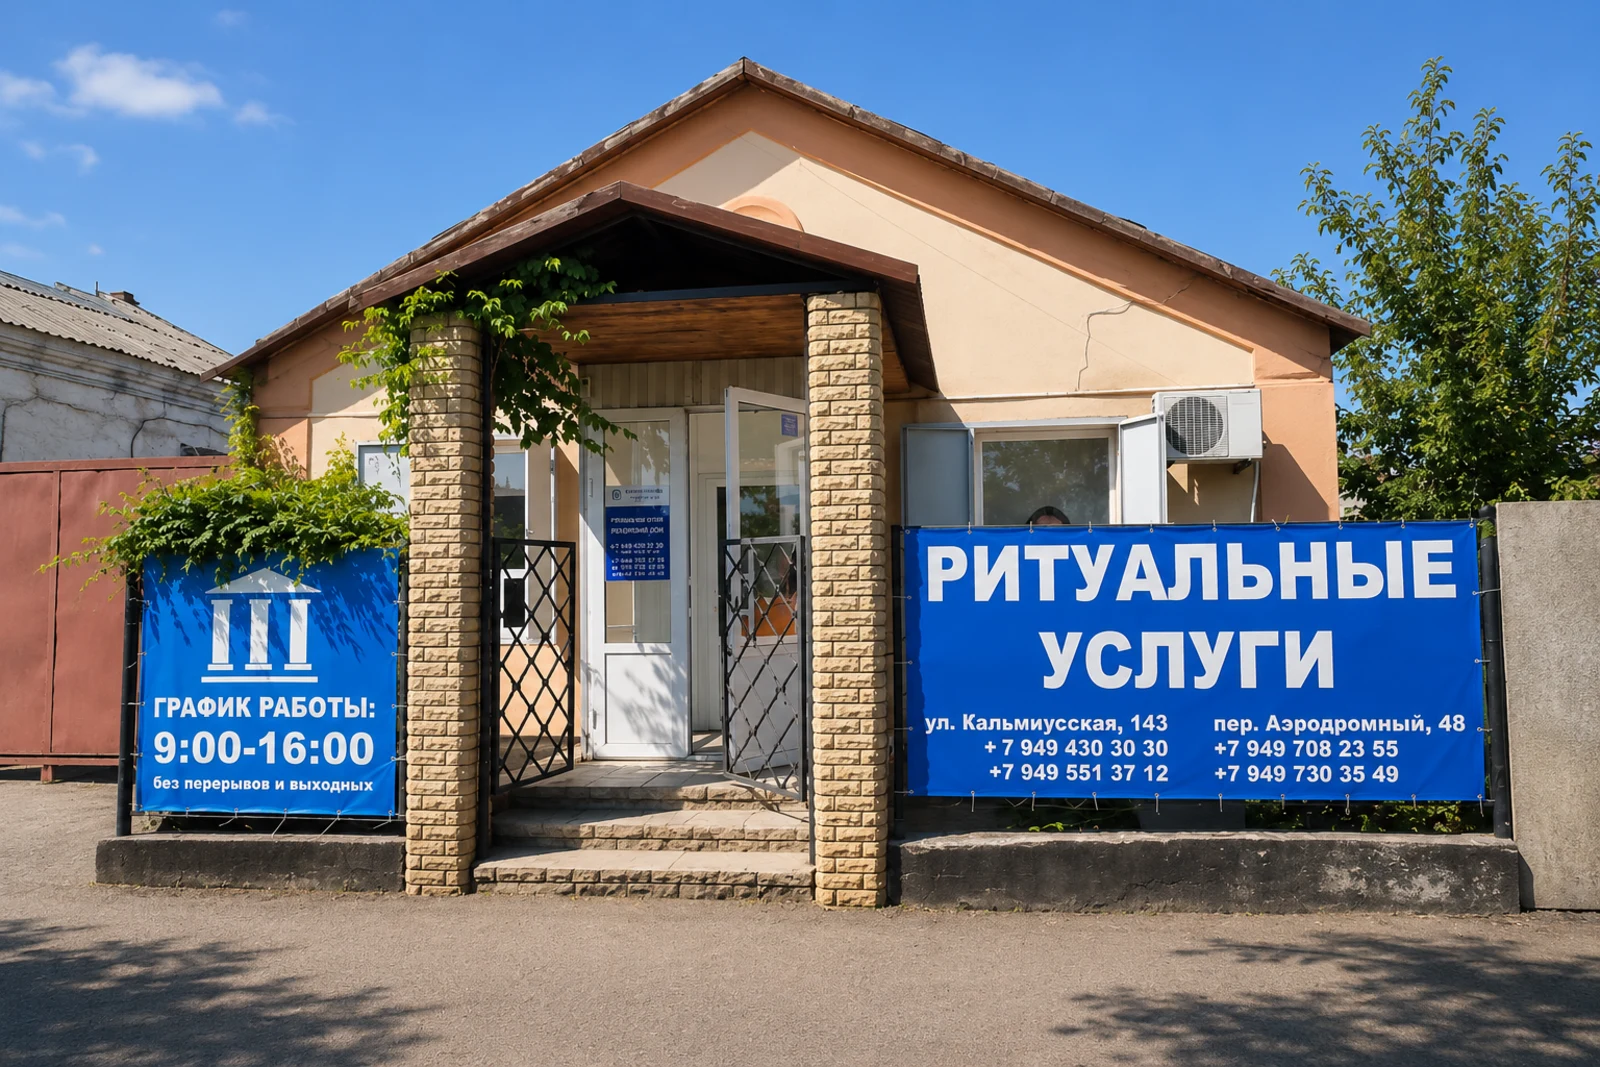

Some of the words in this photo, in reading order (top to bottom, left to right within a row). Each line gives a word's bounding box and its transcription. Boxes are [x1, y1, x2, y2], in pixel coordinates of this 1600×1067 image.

[927, 539, 1457, 602] РИТУАЛЬНЫЕ
[1038, 630, 1334, 690] УСЛУГИ
[154, 696, 252, 718] ГРАФИК
[259, 696, 375, 718] РАБОТЫ:
[924, 717, 955, 735] ул.
[962, 713, 1123, 736] Кальмиусская,
[1130, 714, 1168, 732] 143
[1214, 718, 1259, 736] пер.
[1265, 714, 1432, 736] Аэродромный,
[1438, 714, 1466, 732] 48
[153, 730, 374, 766] 9:00-16:00
[1020, 738, 1058, 757] 949
[1064, 739, 1103, 757] 430
[1110, 739, 1136, 757] 30
[1143, 739, 1169, 757] 30
[1214, 739, 1240, 757] +7
[1246, 739, 1286, 758] 949
[1292, 739, 1332, 758] 708
[1338, 739, 1365, 758] 23
[1372, 740, 1399, 758] 55
[989, 763, 1014, 780] +7
[1021, 763, 1059, 781] 949
[1066, 763, 1103, 781] 551
[1110, 764, 1136, 781] 37
[1143, 764, 1169, 782] 12
[1214, 765, 1240, 782] +7
[1247, 764, 1286, 783] 949
[1293, 764, 1332, 783] 730
[1339, 765, 1366, 783] 35
[1371, 765, 1399, 783] 49
[153, 775, 180, 790] без
[184, 779, 270, 793] перерывов
[275, 780, 285, 791] и
[289, 780, 373, 794] выходных
